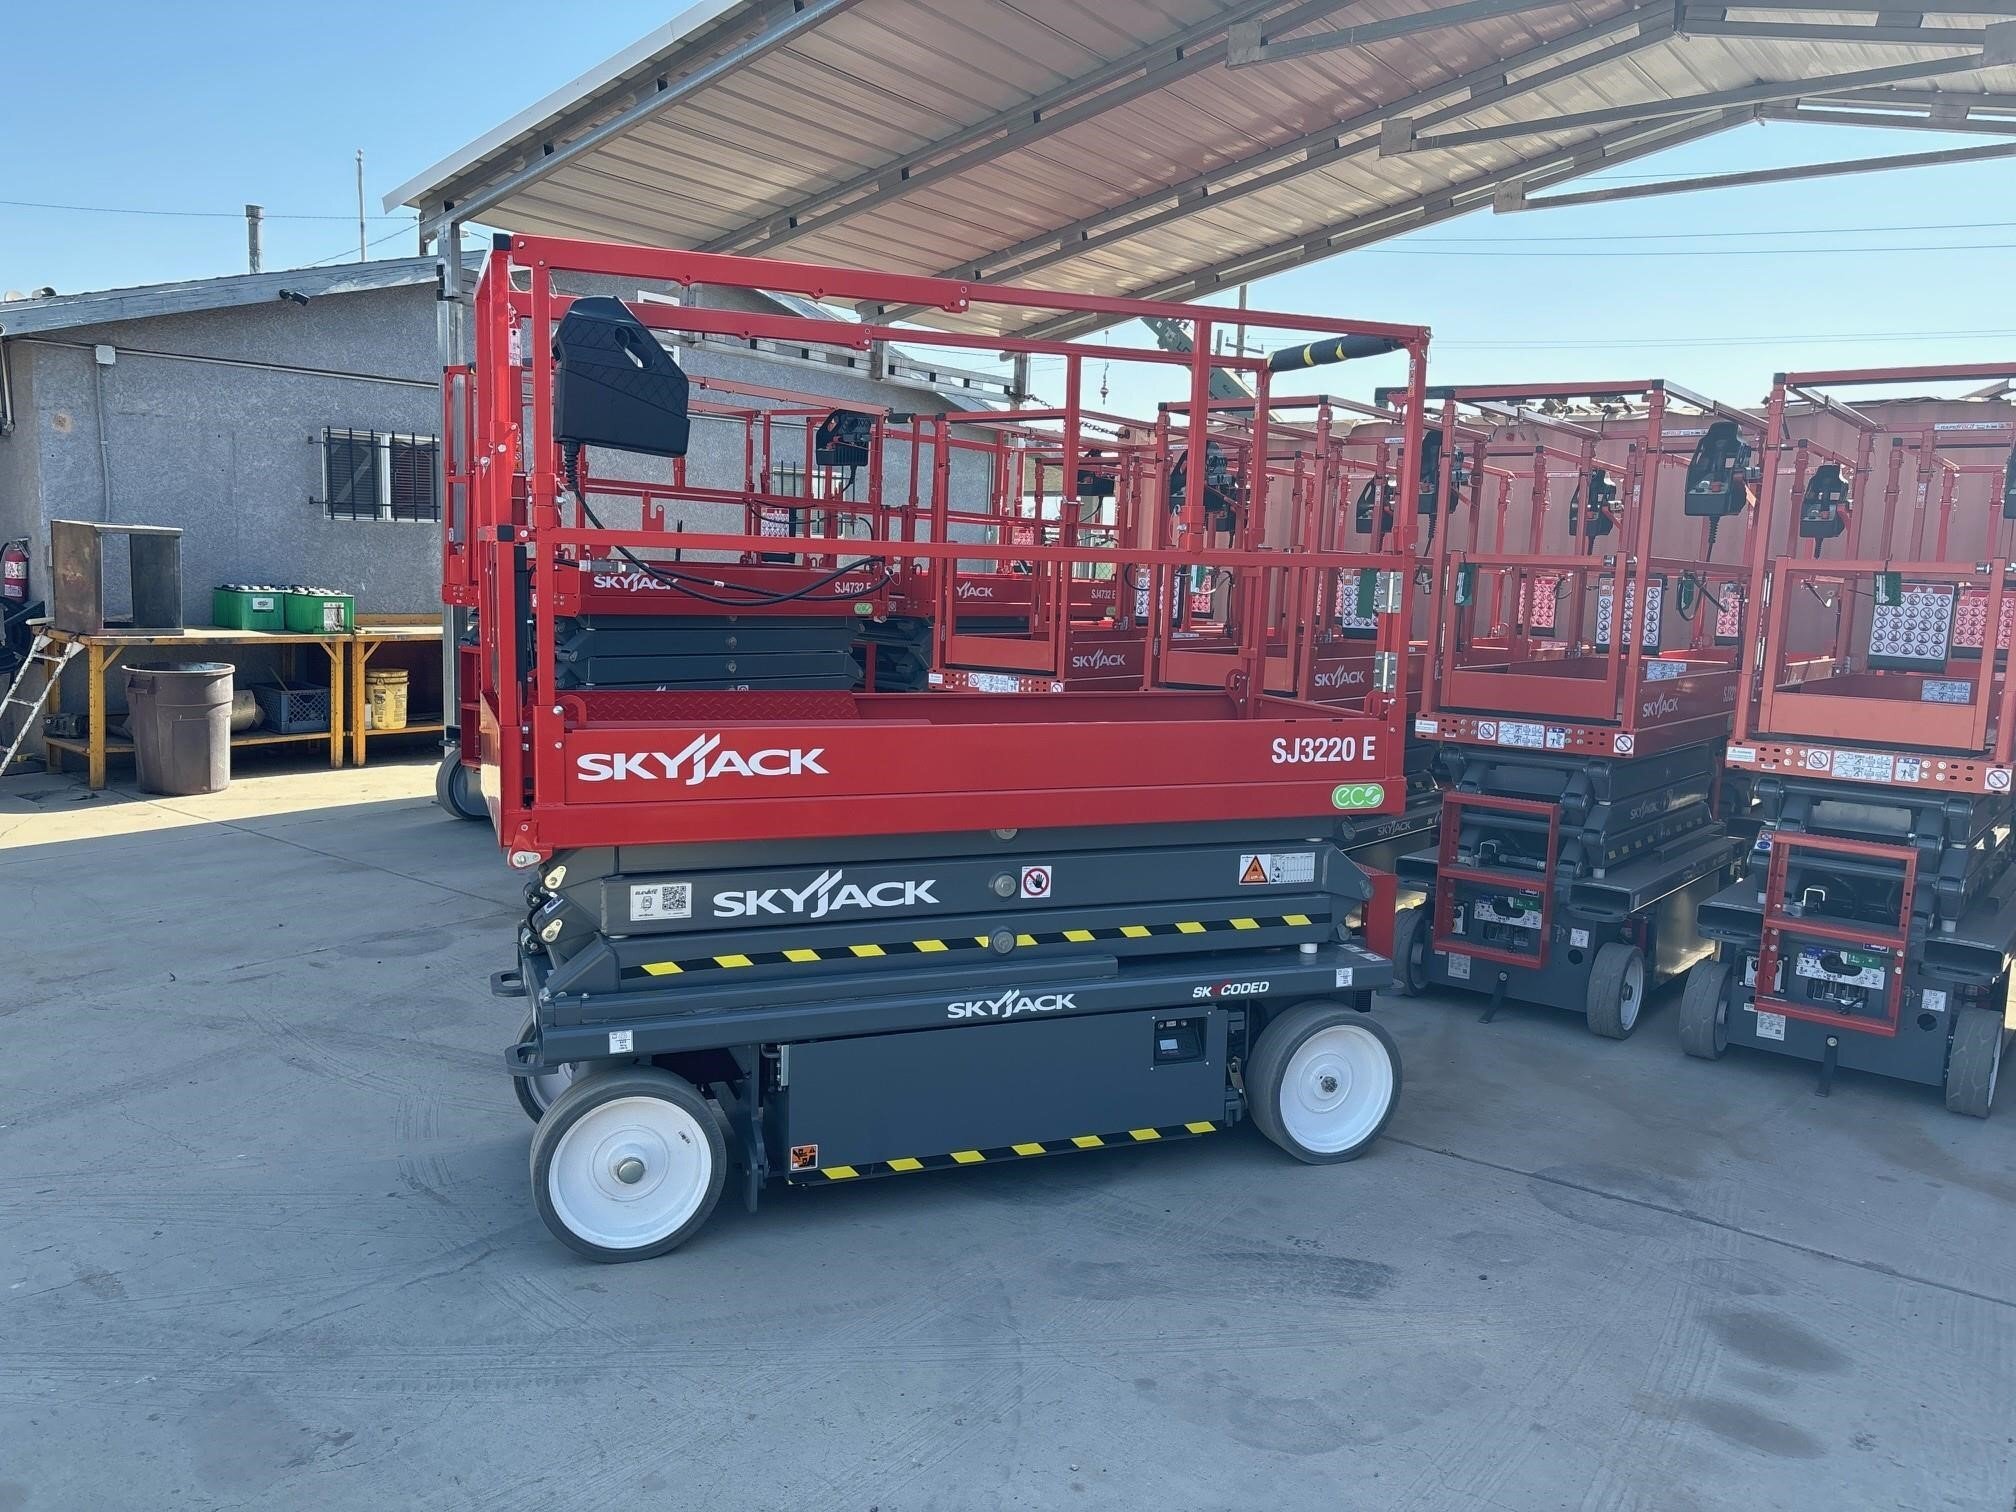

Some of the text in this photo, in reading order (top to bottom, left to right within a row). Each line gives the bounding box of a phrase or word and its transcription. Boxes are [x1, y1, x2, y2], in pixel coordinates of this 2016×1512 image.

[834, 581, 864, 593] SJ4732
[953, 581, 993, 599] YJACK
[1072, 648, 1126, 669] SKYJACK
[1314, 665, 1365, 688] SKYJACK
[1643, 693, 1679, 719] SKYJACK
[577, 733, 829, 786] SKYJACK
[1271, 735, 1376, 764] SJ3220 E
[1335, 786, 1381, 807] eco
[1377, 820, 1411, 836] SKYJACK
[713, 869, 941, 918] SKYJACK
[947, 989, 1077, 1018] SKYJACK
